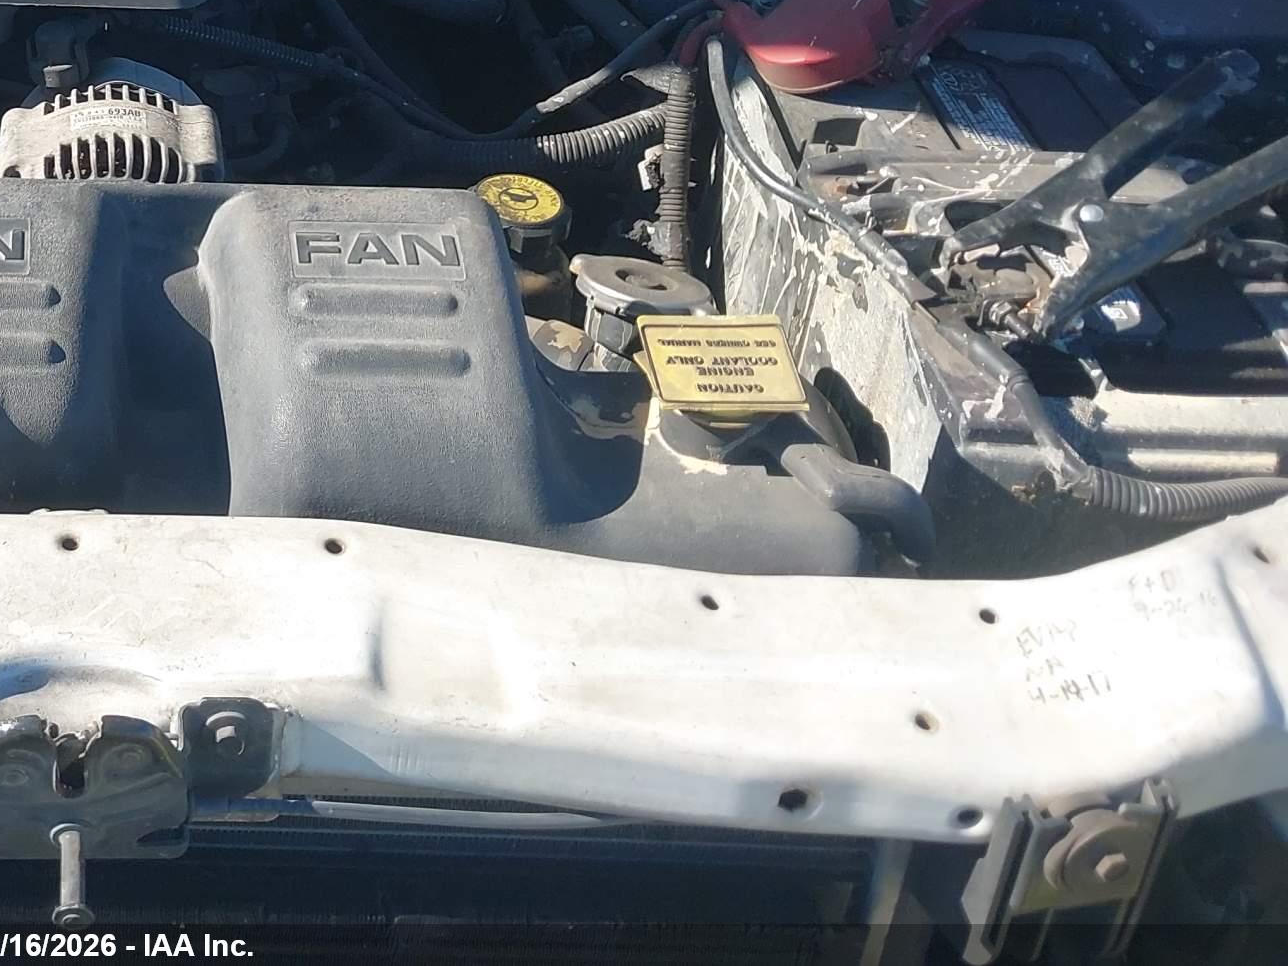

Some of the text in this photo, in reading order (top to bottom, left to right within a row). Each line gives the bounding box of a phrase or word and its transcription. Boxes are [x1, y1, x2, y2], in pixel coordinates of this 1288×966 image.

[293, 230, 463, 269] FAN
[657, 337, 702, 348] MANUAL
[754, 338, 777, 348] SEE
[665, 355, 778, 366] COOLANT ONLY
[696, 366, 755, 377] ENGINE
[696, 383, 765, 394] CAUTION
